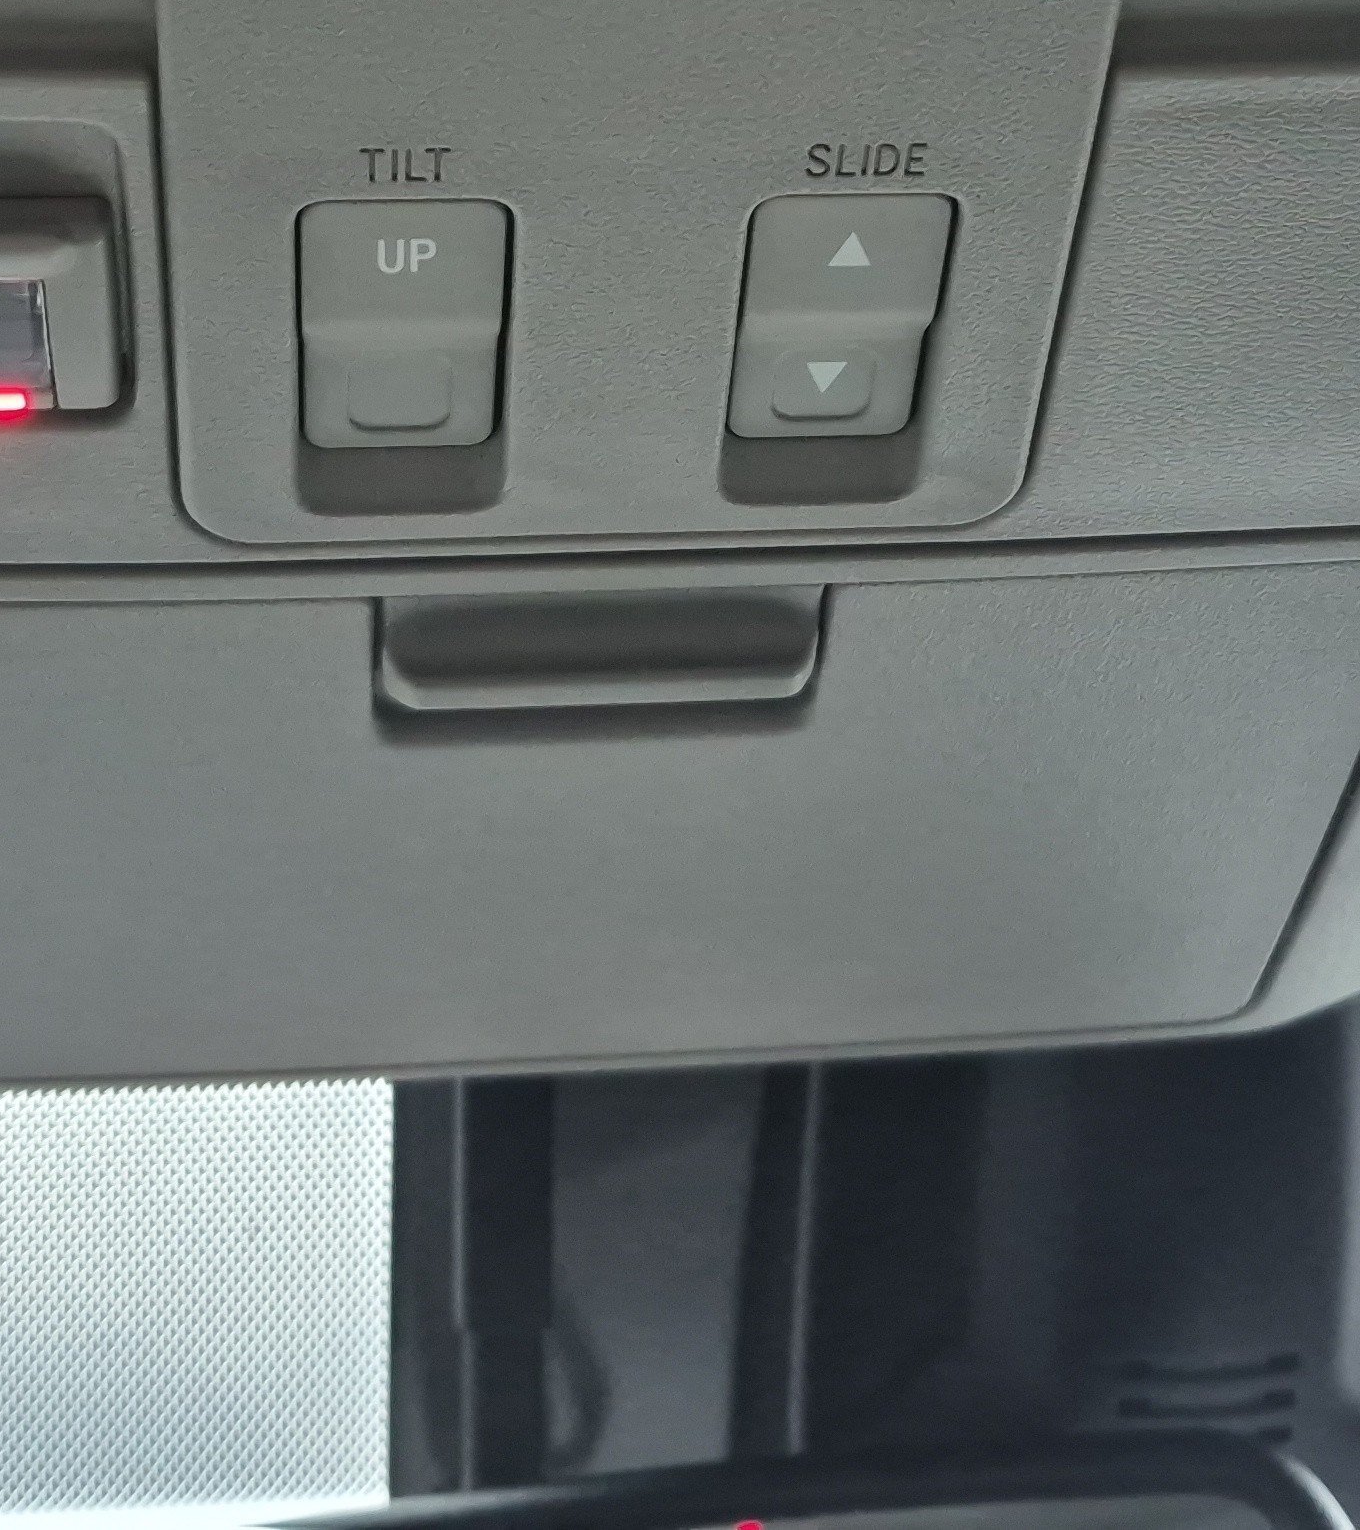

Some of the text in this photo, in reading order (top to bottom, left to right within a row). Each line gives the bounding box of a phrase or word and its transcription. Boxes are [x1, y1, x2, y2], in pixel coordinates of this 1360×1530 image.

[358, 146, 452, 185] TILT
[804, 142, 929, 179] SLIDE
[376, 237, 438, 274] UP
